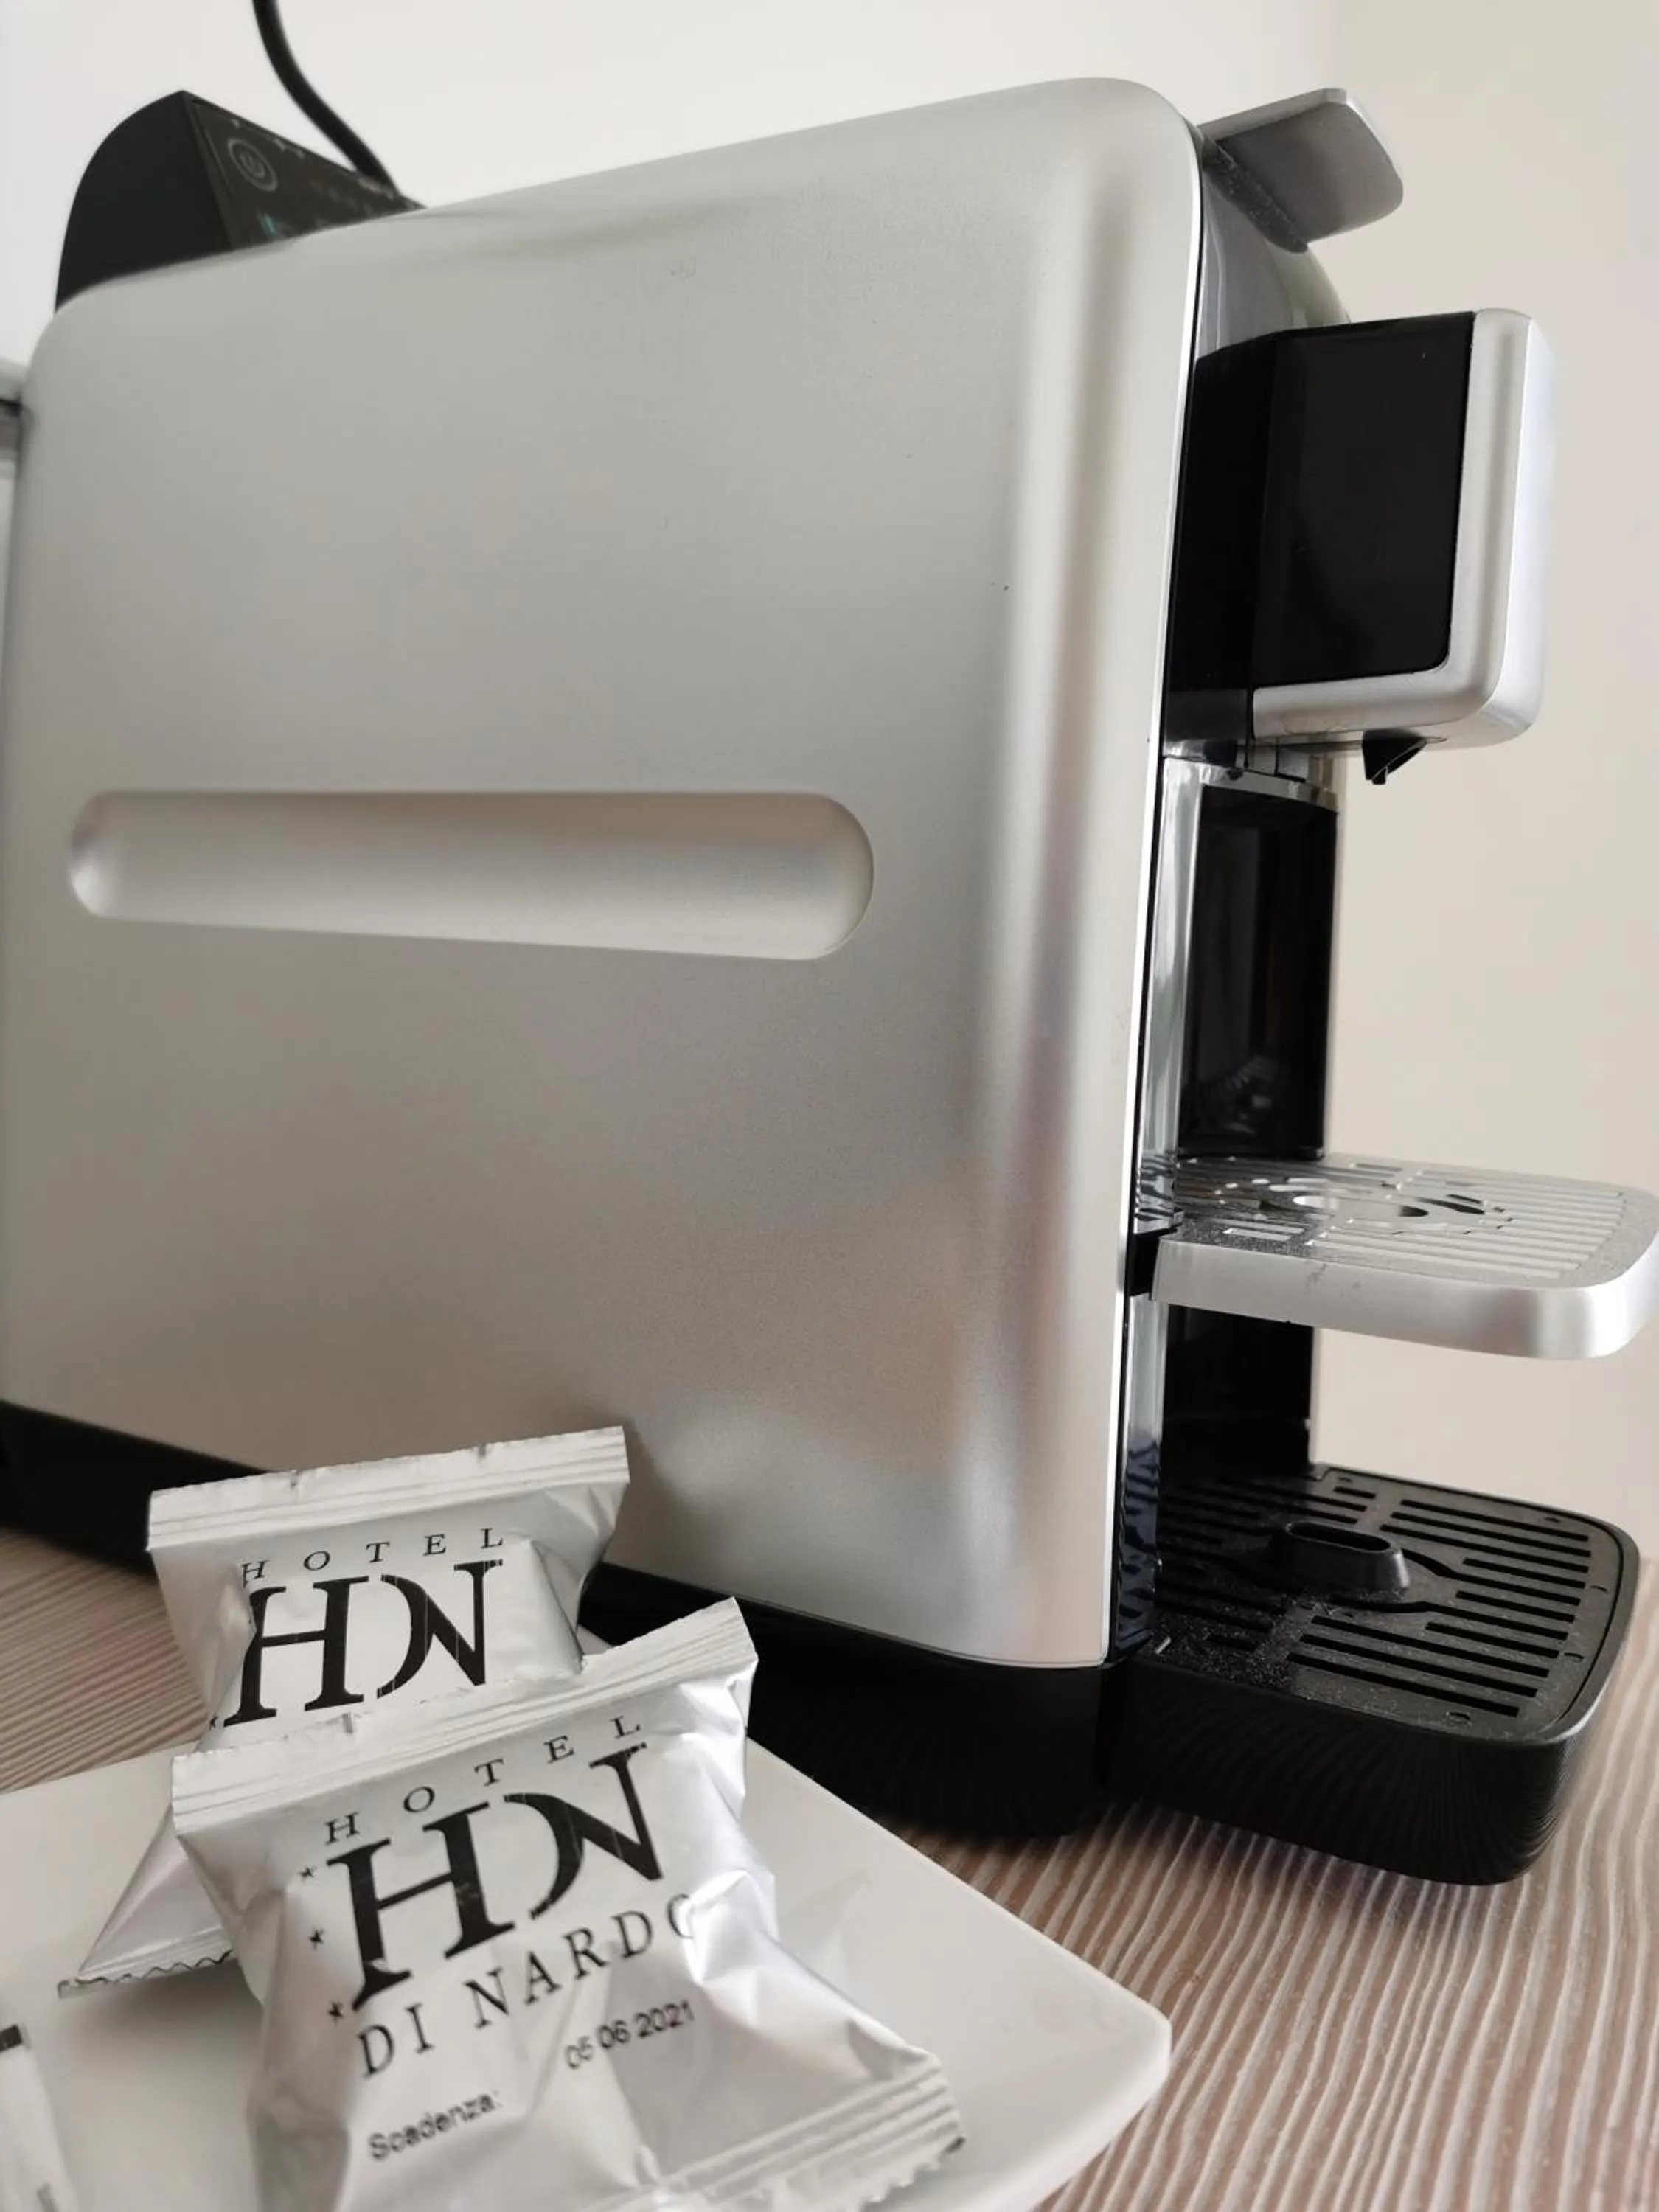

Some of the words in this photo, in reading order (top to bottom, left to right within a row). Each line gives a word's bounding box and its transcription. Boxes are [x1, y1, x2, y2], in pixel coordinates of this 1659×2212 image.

[242, 1528, 503, 1586] HOTEL
[223, 1559, 503, 1727] HDN
[325, 1716, 641, 1844] HOTEL
[327, 1742, 663, 2011] HDN
[358, 2003, 435, 2078] DI
[463, 1893, 694, 2029] NARDO
